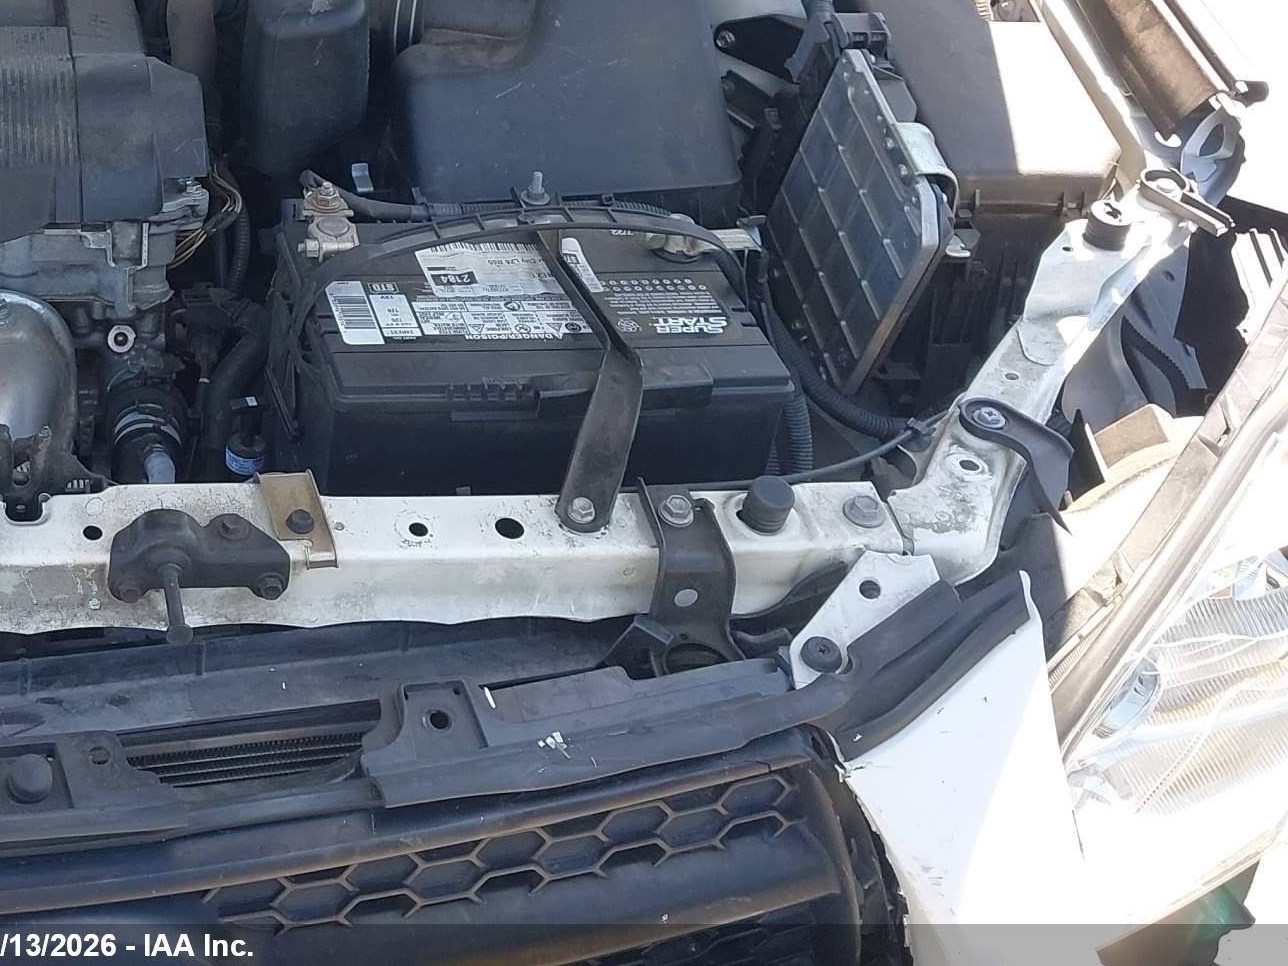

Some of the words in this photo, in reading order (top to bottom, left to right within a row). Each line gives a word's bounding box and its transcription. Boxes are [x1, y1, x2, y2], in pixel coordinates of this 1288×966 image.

[440, 274, 470, 284] 2184
[371, 283, 395, 292] STD
[654, 316, 728, 327] START
[656, 325, 724, 334] SUPER
